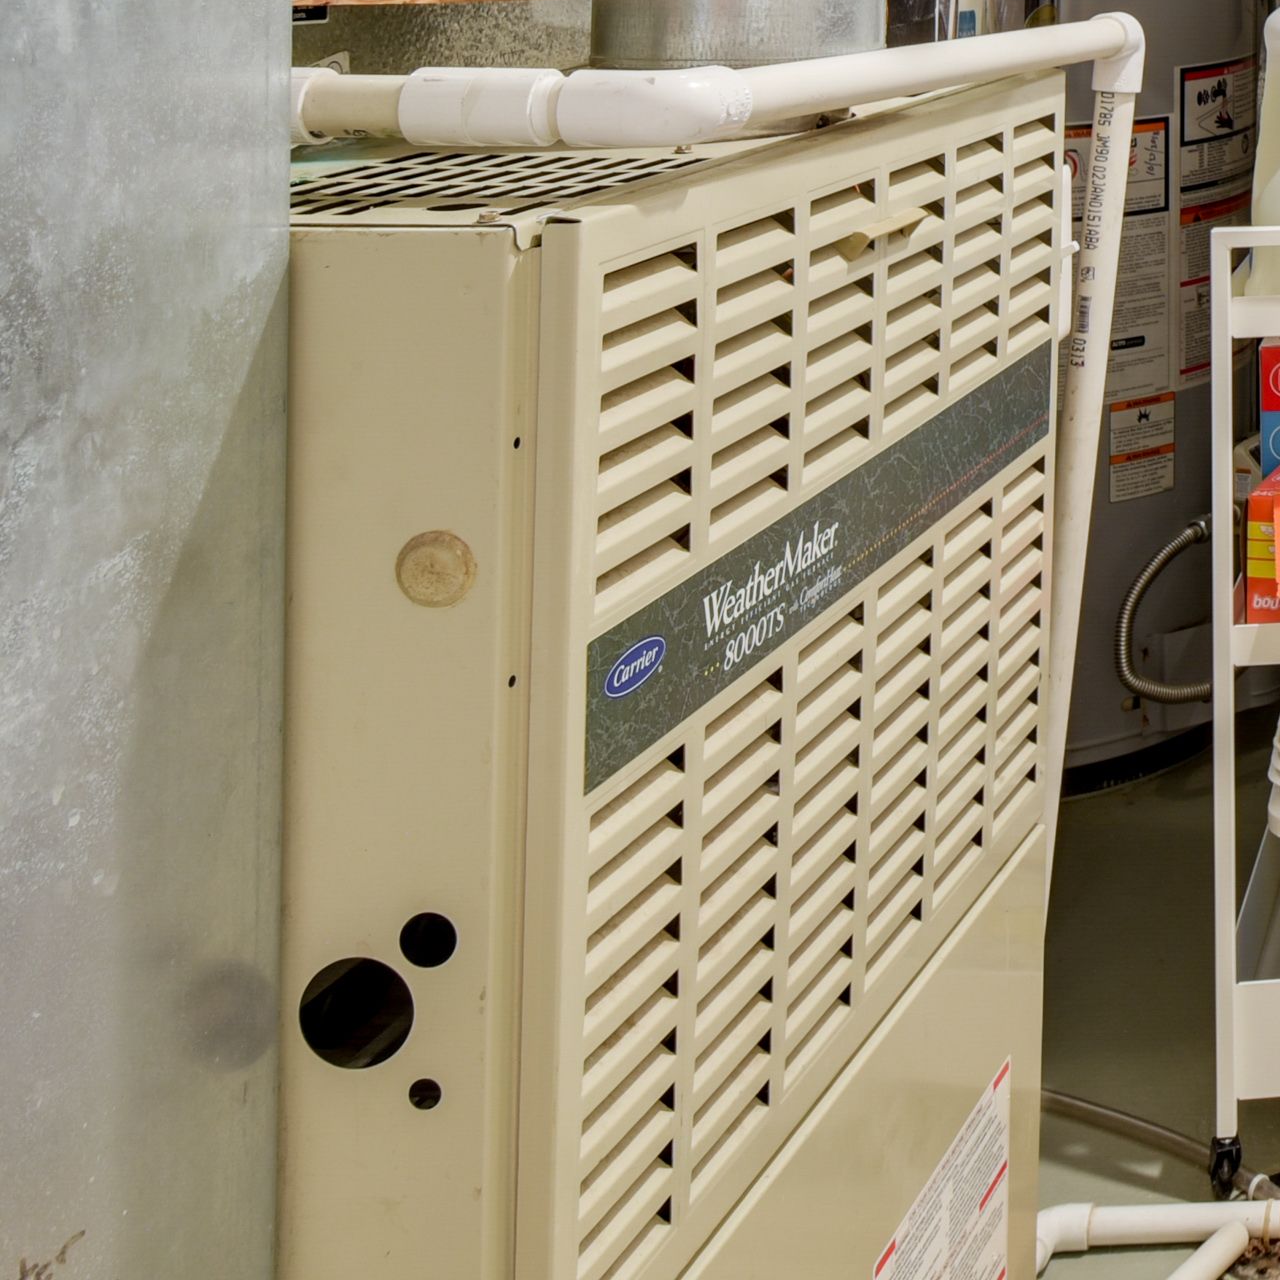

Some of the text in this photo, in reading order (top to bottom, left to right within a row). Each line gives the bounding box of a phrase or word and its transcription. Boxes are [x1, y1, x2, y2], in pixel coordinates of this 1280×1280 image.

[703, 520, 839, 638] WeatherMaker
[613, 645, 659, 688] Carrier
[724, 602, 785, 671] 8000TS
